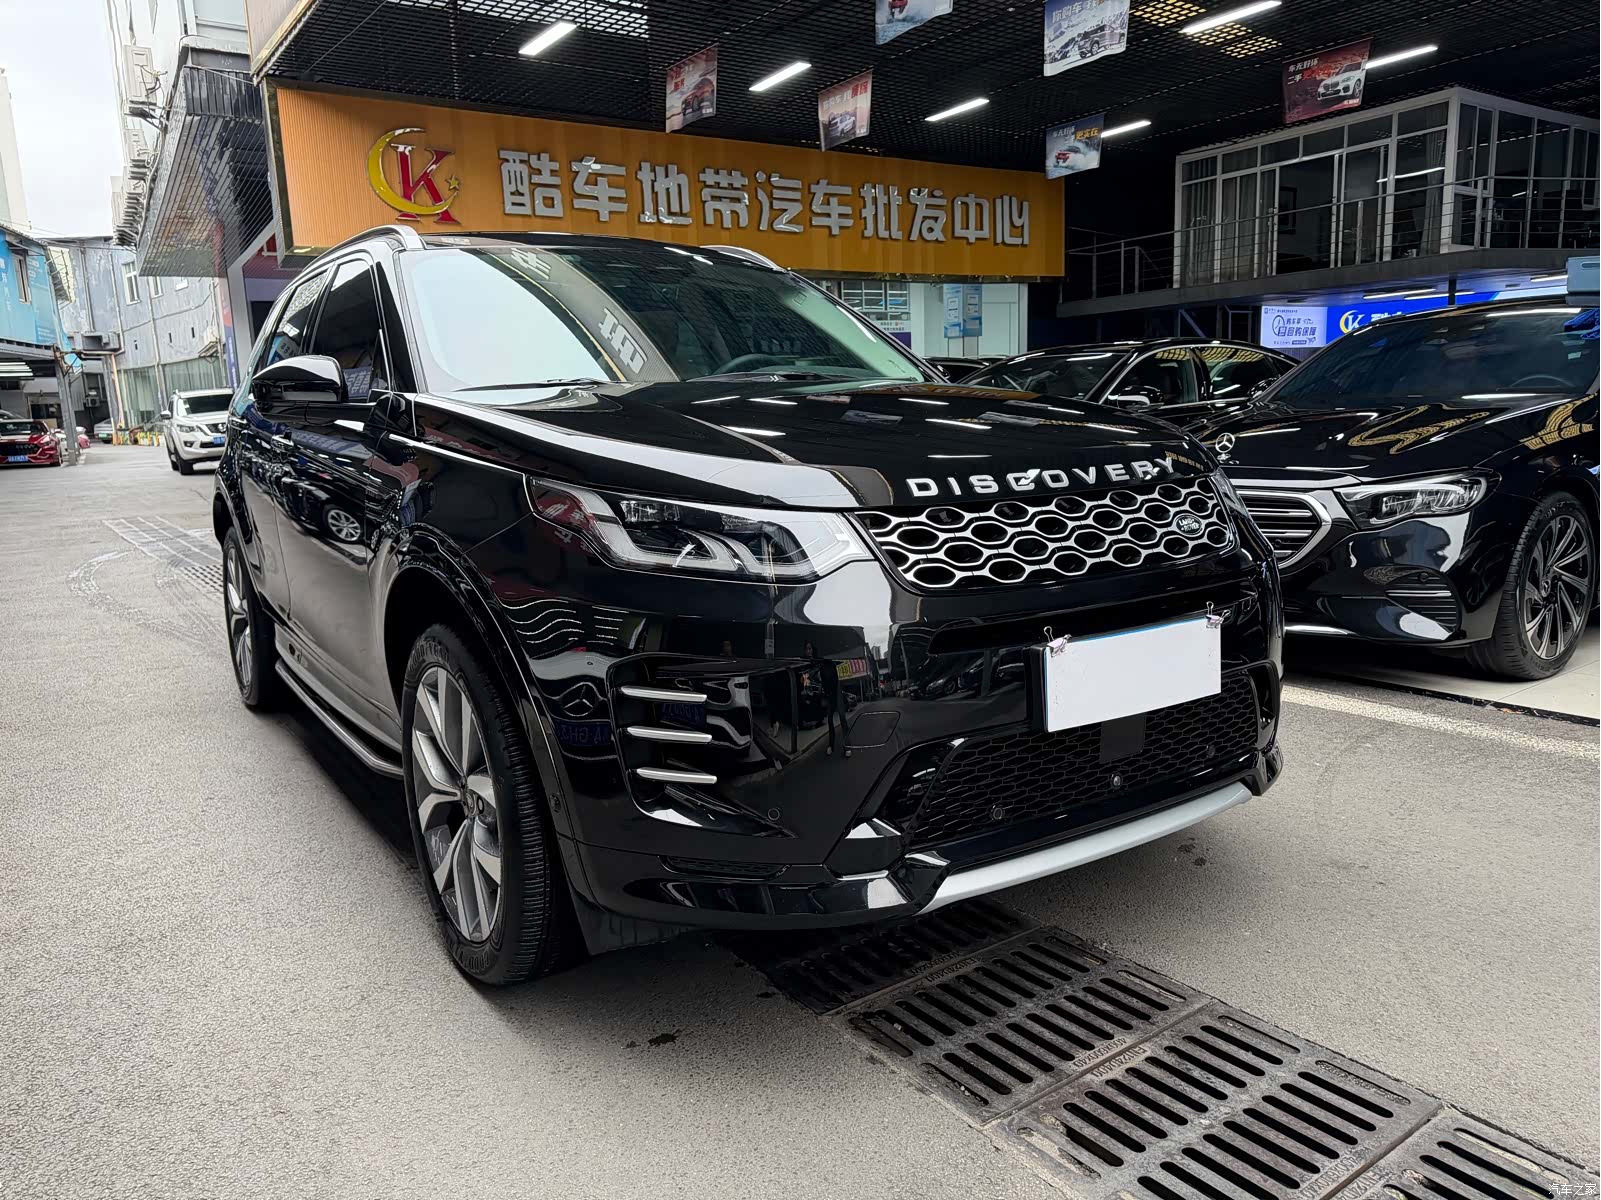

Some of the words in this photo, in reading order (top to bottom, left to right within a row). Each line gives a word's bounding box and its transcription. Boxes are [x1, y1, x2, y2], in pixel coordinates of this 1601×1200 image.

[499, 148, 1031, 247] 酷车地带汽车批发中心
[905, 457, 1177, 498] DISCOVERY
